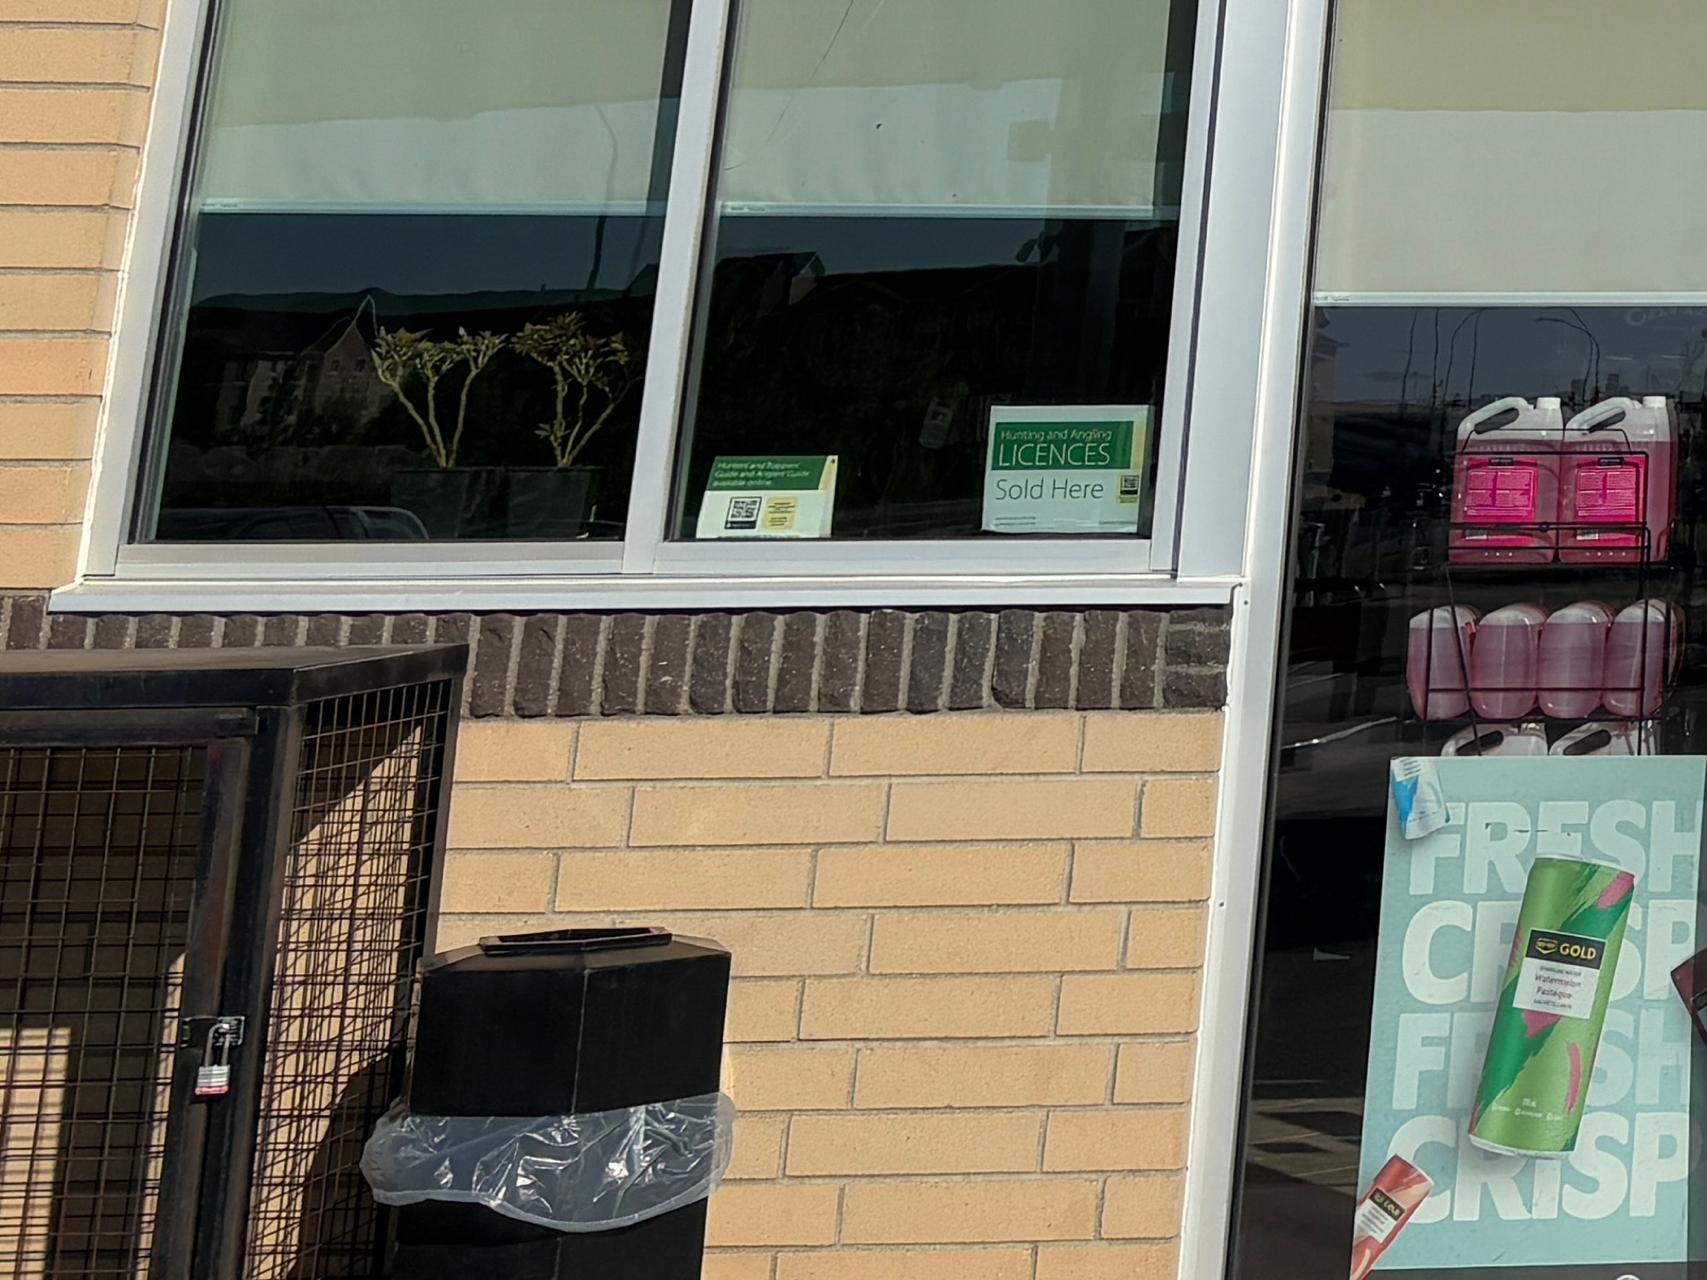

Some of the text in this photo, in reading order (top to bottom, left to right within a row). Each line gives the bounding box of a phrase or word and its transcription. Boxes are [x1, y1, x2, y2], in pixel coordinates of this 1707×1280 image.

[1001, 429, 1112, 441] Hunting and Angling
[999, 443, 1110, 466] LICENCES
[995, 477, 1104, 500] Sold Here
[1560, 943, 1597, 960] GOLD
[1386, 1110, 1702, 1225] CRISP
